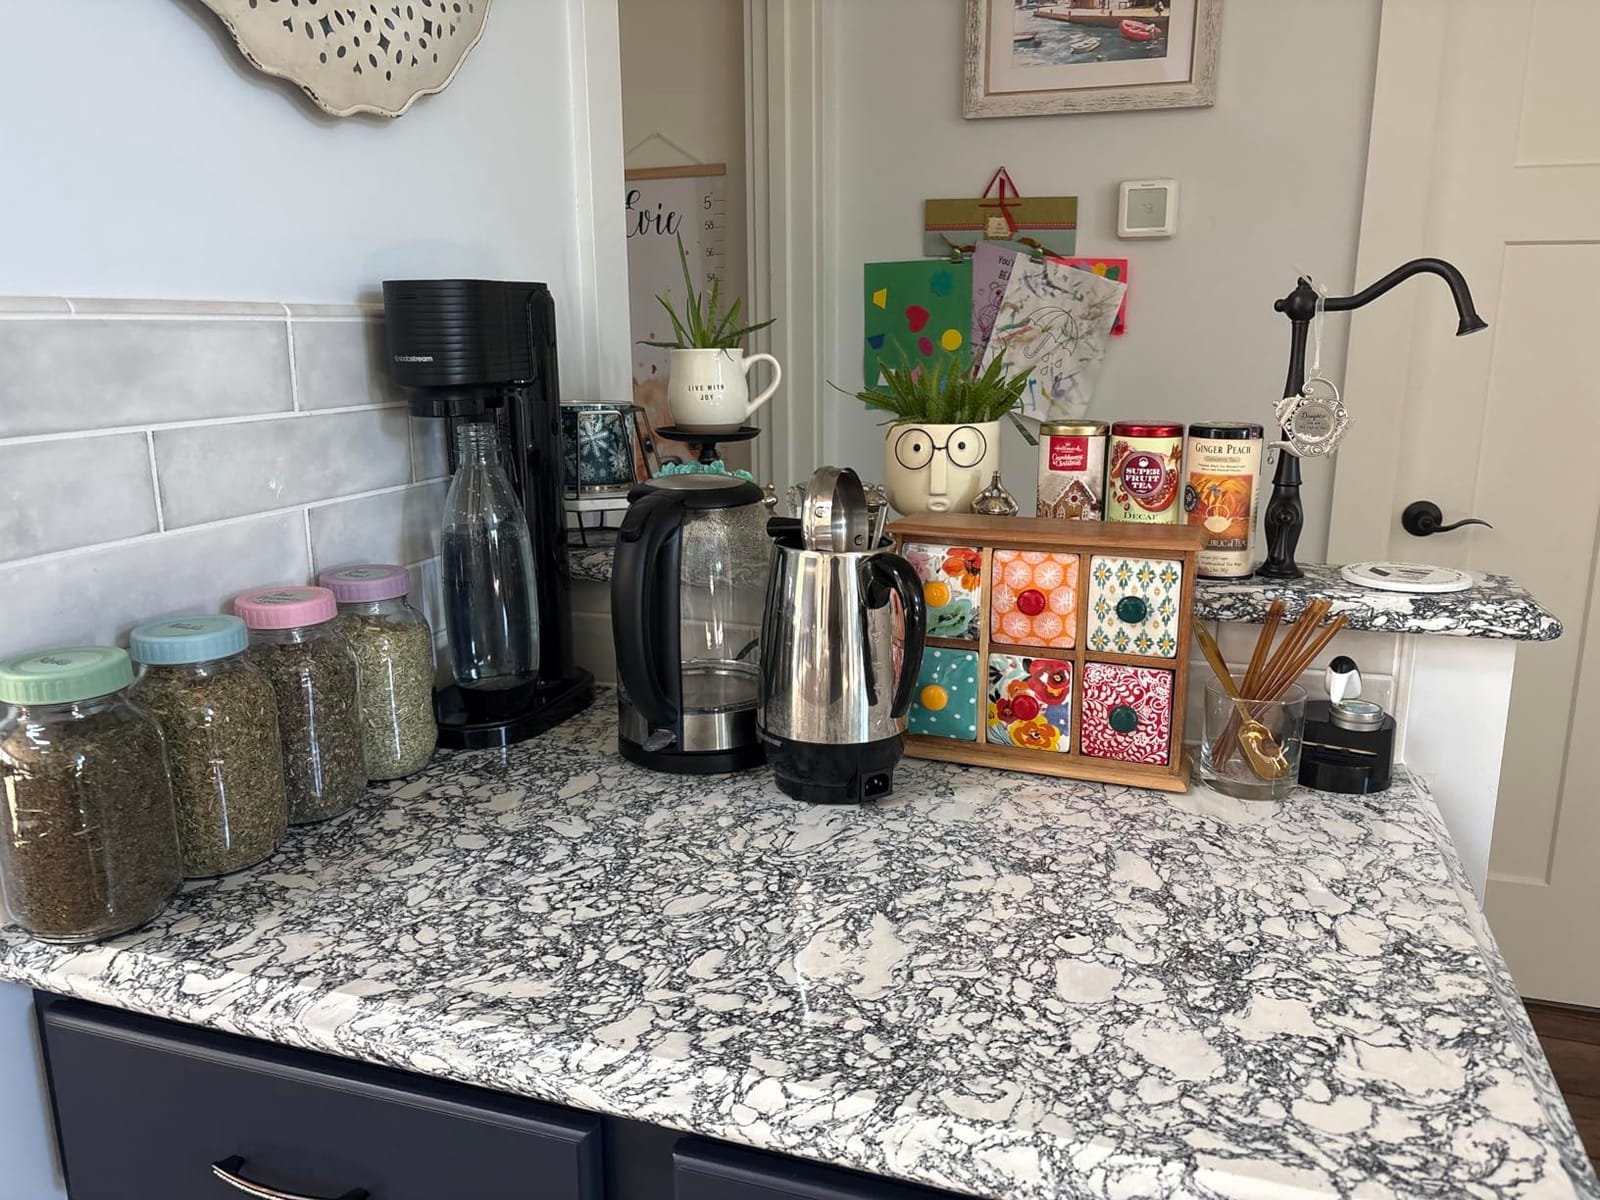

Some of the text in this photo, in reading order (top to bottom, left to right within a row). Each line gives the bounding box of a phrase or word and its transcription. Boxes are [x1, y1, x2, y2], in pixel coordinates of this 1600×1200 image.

[625, 189, 683, 238] Evie
[688, 384, 704, 392] LIVE
[1195, 441, 1251, 455] GINGER PEACH
[1125, 467, 1161, 475] SUPER
[1125, 474, 1160, 482] FRUIT
[1131, 481, 1153, 489] TEA
[1123, 511, 1158, 520] DECAF
